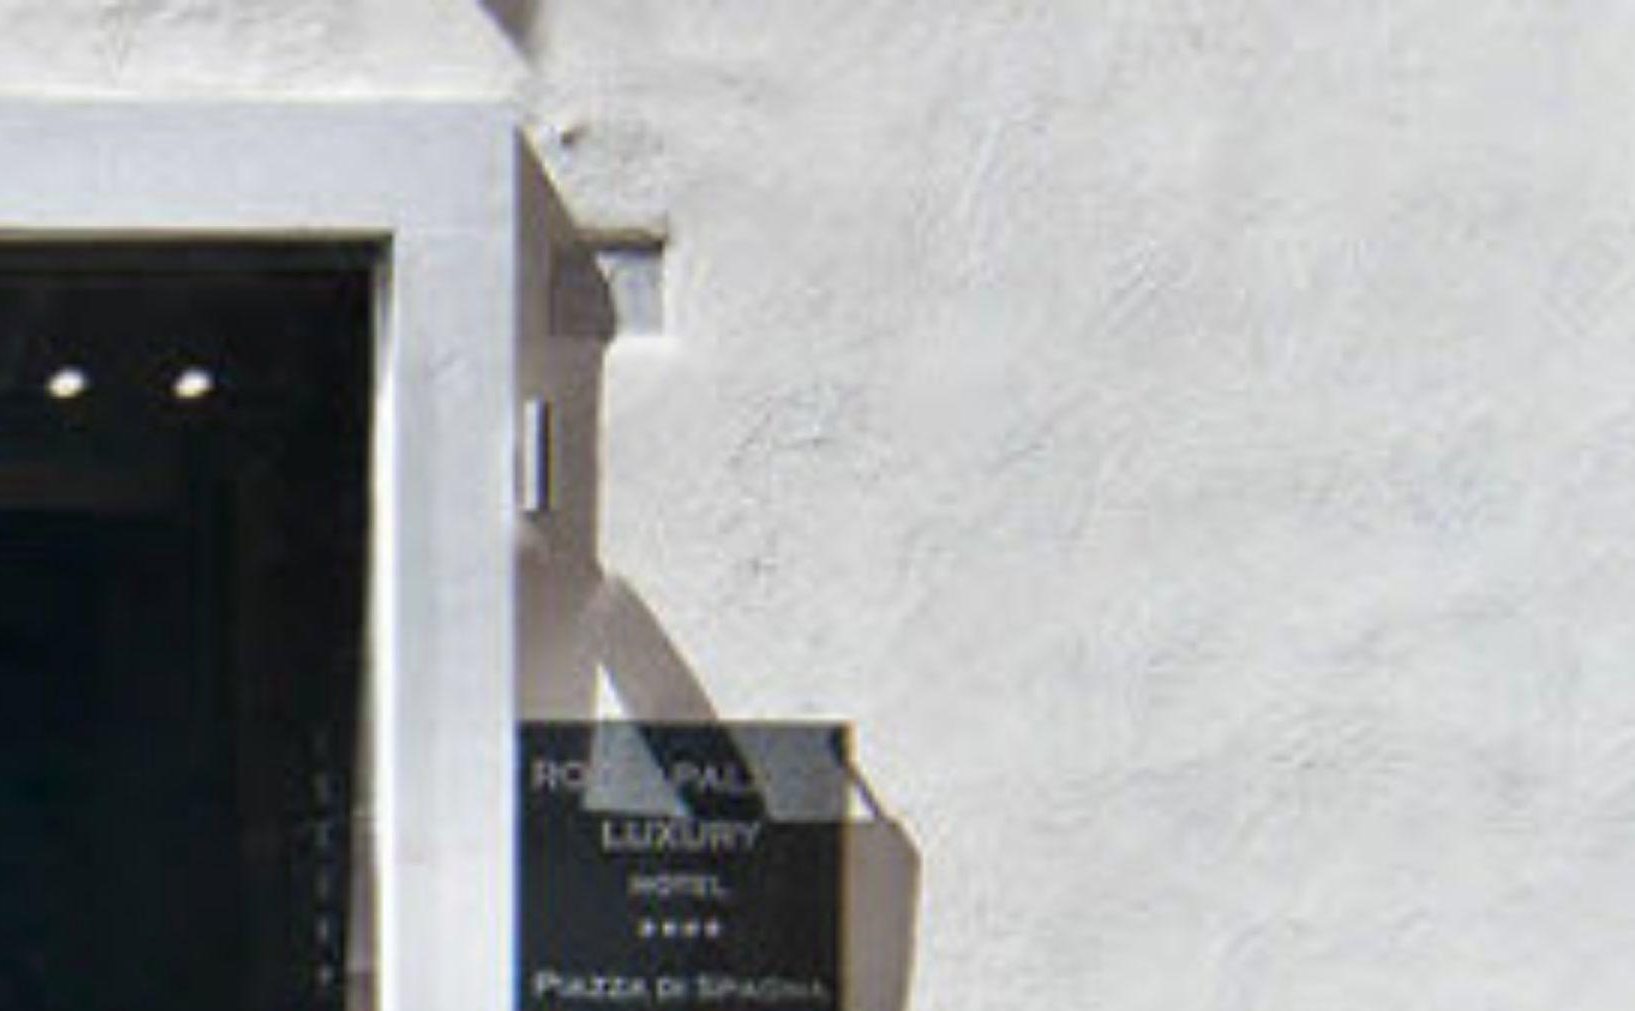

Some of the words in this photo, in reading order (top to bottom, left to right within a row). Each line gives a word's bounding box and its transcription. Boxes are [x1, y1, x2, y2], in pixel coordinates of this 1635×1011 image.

[601, 818, 762, 854] LUXURY
[627, 874, 724, 900] HOTEL
[534, 971, 653, 1001] PIAZZA
[695, 972, 830, 1005] SPAGNA
